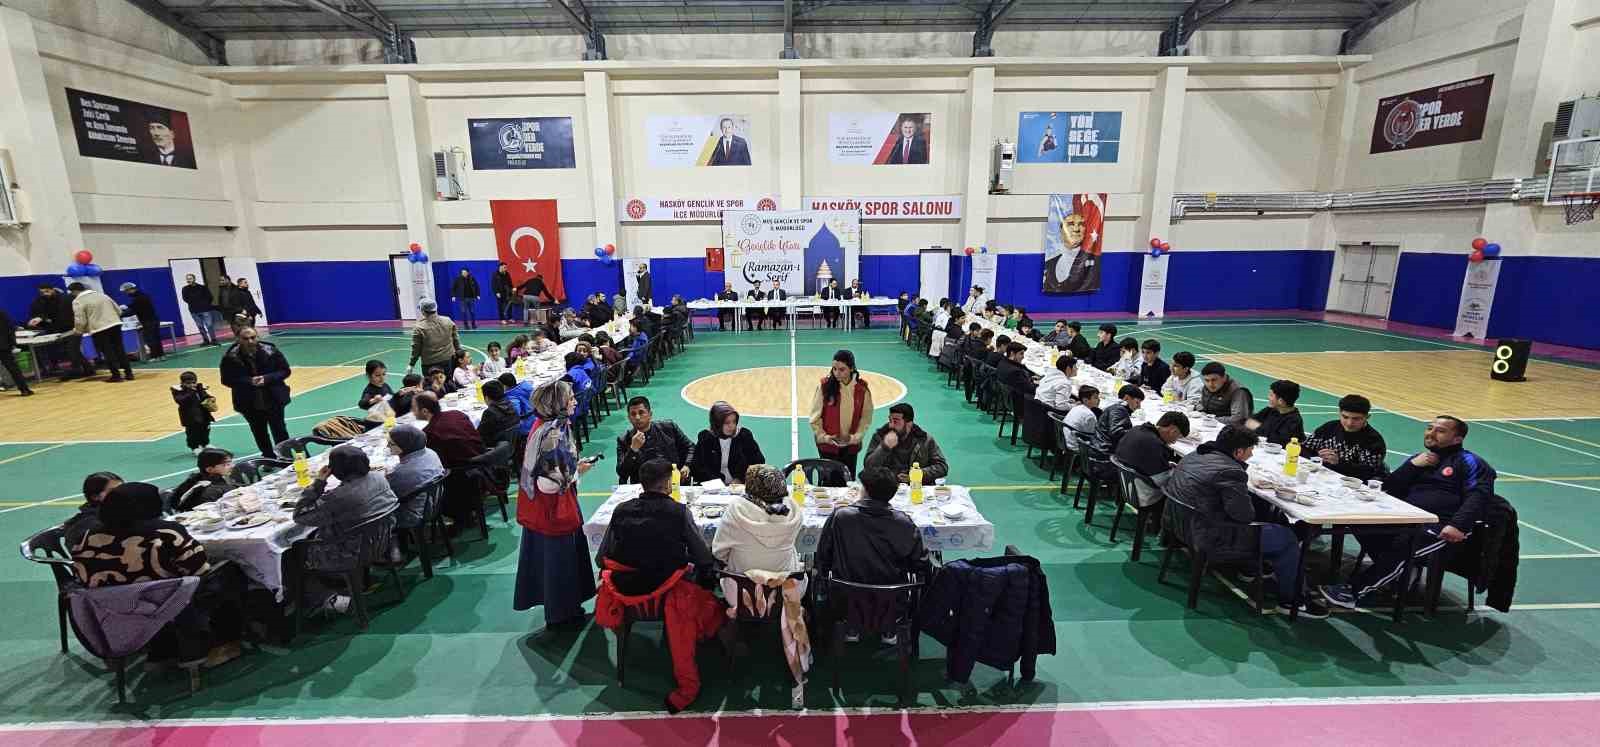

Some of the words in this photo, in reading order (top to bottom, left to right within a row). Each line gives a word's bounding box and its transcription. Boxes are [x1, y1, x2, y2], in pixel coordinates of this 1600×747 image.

[726, 200, 744, 208] SPOR
[865, 202, 898, 216] SPOR
[903, 202, 953, 216] SALONU
